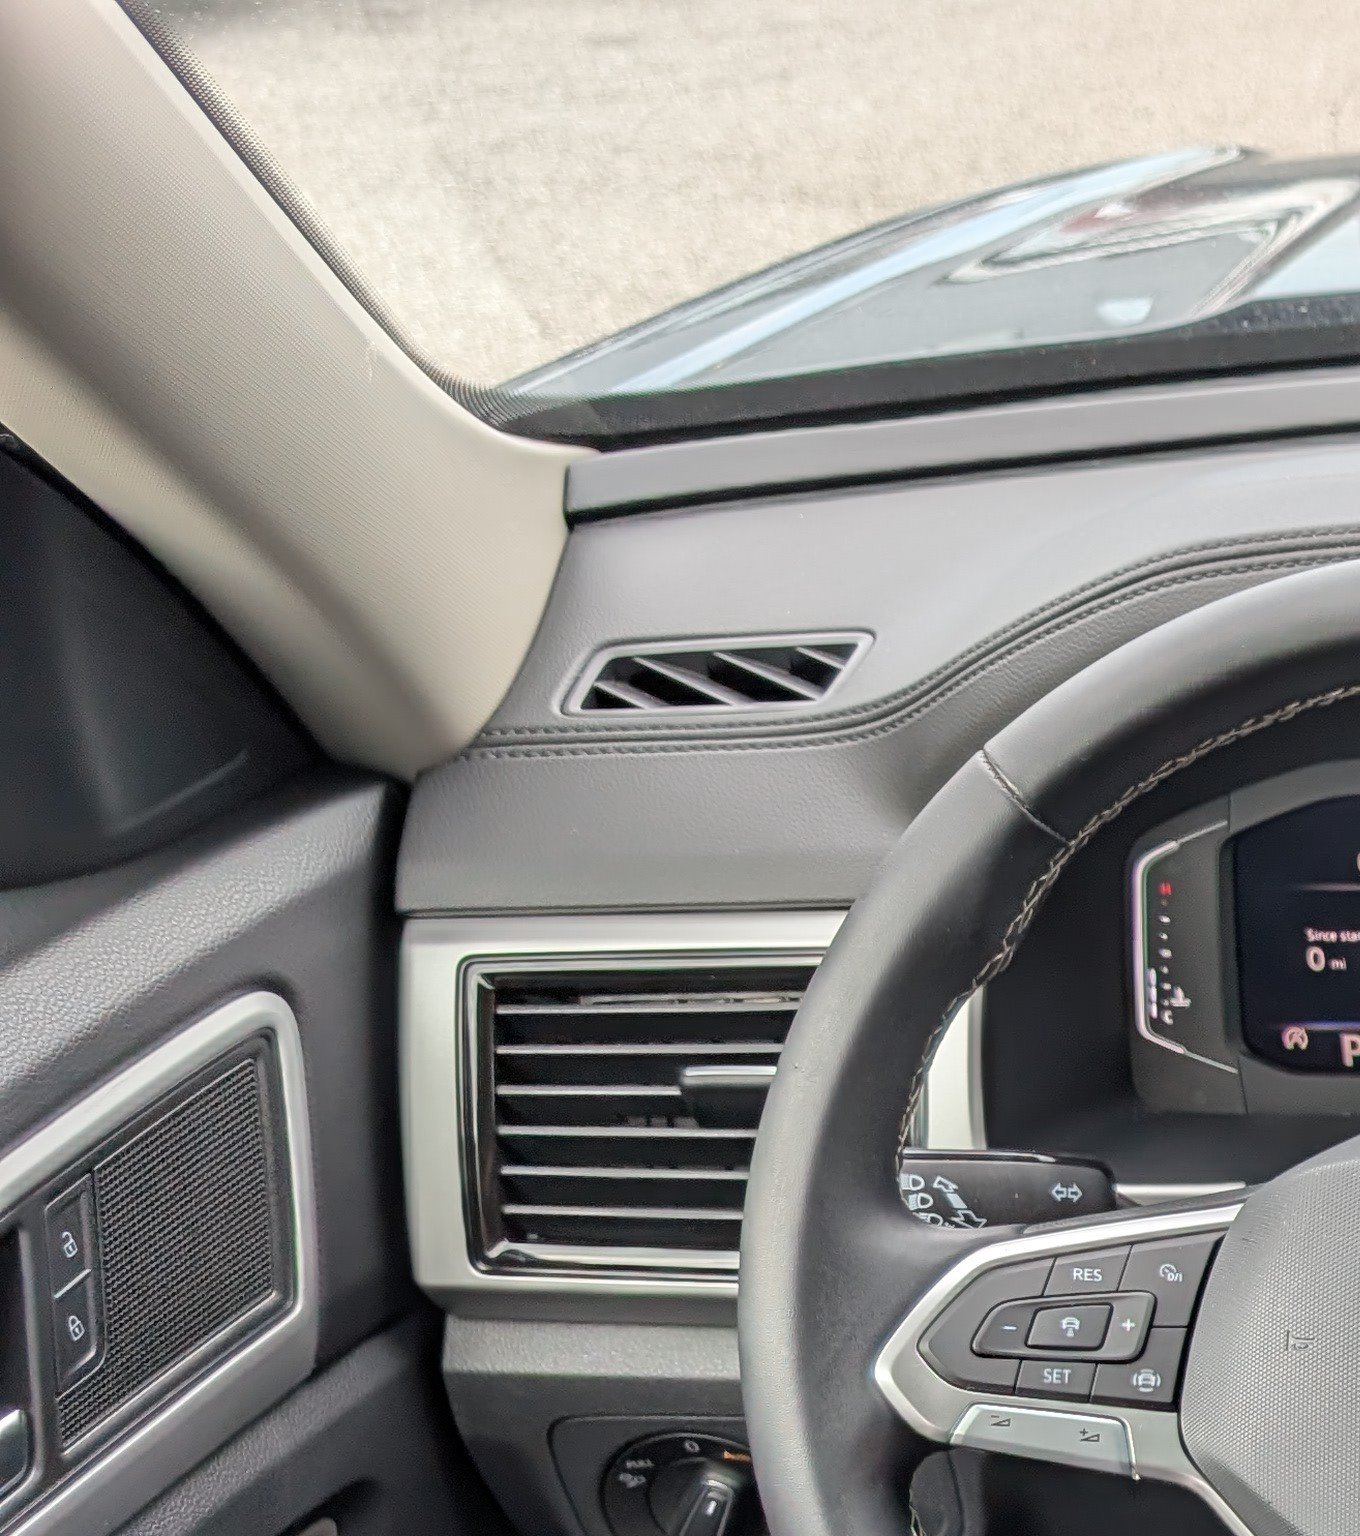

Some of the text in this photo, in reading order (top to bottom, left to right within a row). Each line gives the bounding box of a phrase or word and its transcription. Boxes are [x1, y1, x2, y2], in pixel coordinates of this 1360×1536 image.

[1304, 927, 1337, 943] Since
[1305, 945, 1347, 972] 0 mi
[1072, 1266, 1103, 1283] RES
[1042, 1368, 1072, 1385] SET
